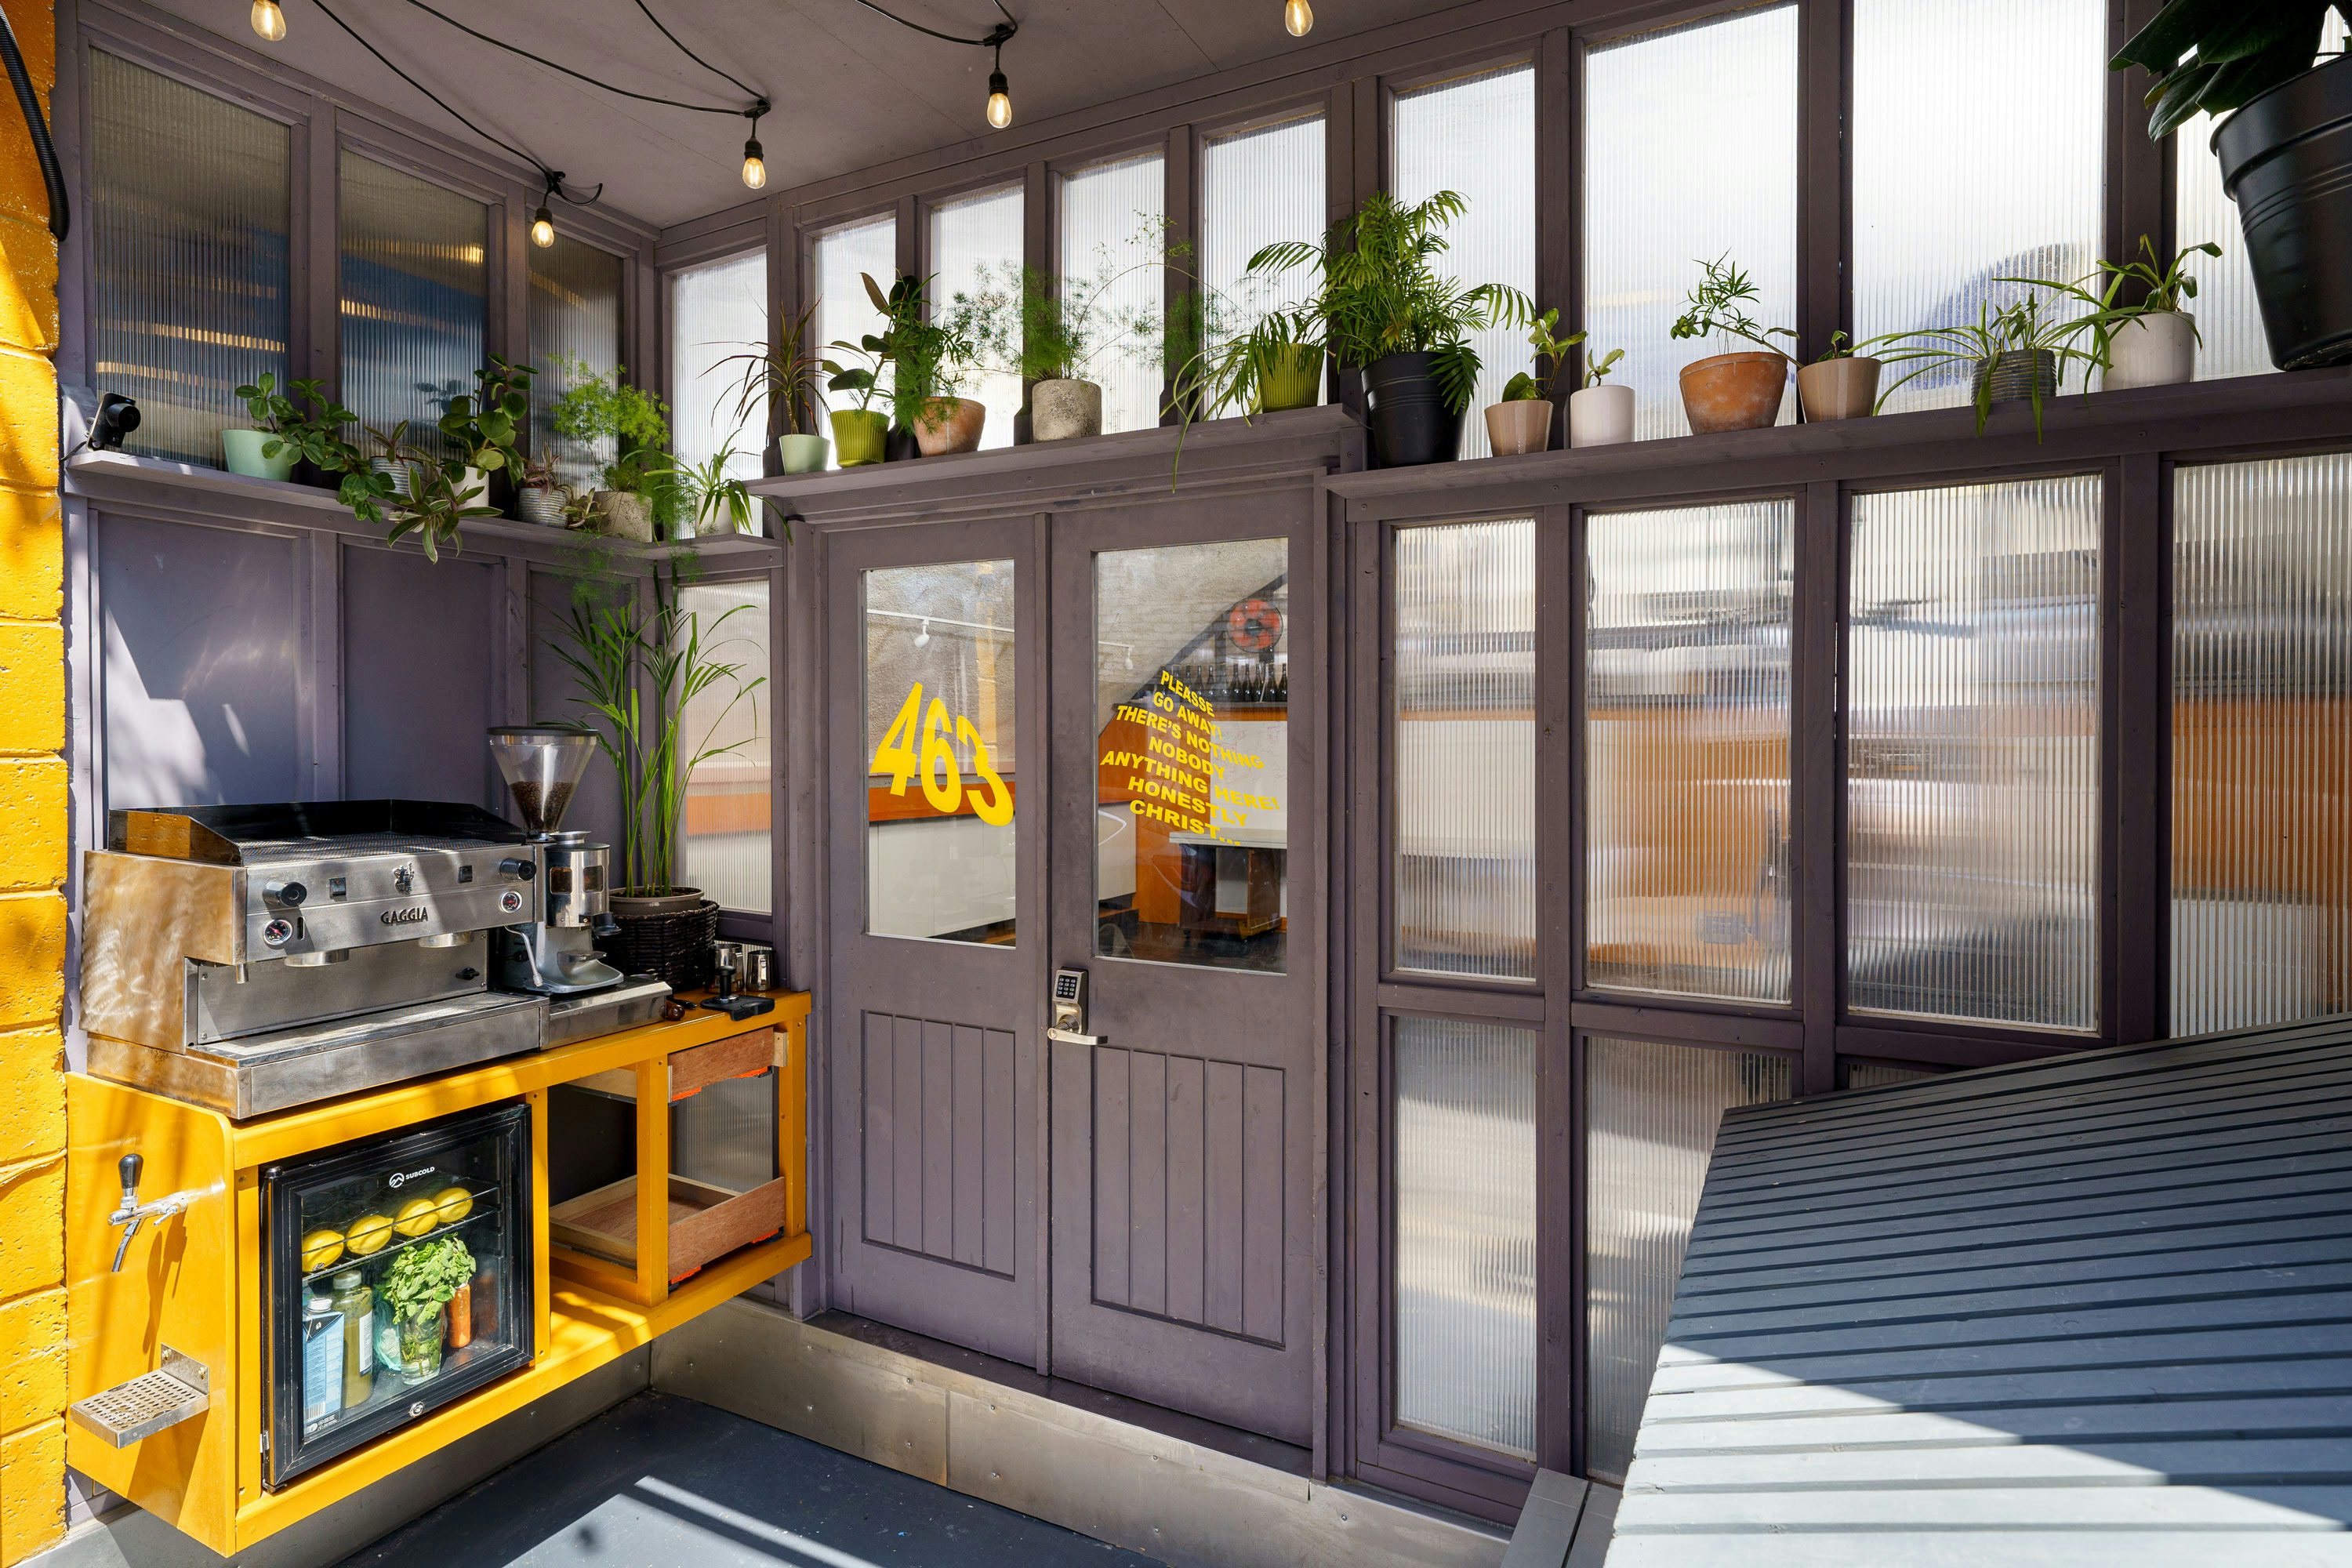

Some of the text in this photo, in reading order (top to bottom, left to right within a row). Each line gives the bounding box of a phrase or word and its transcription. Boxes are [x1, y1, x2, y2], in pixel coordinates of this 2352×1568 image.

[1153, 691, 1223, 740] GO AWAY!
[1160, 670, 1215, 717] PLEASSE
[869, 681, 1014, 826] 463
[1116, 706, 1265, 769] THERE'S NOTHING
[1149, 736, 1225, 780] NOBODY
[1100, 750, 1280, 810] ANYTHING HERE!
[1127, 775, 1248, 826] HONESTLY
[1130, 800, 1241, 846] CHRIST...
[380, 906, 428, 925] GAGGIA
[405, 1167, 435, 1180] SUBCOLD
